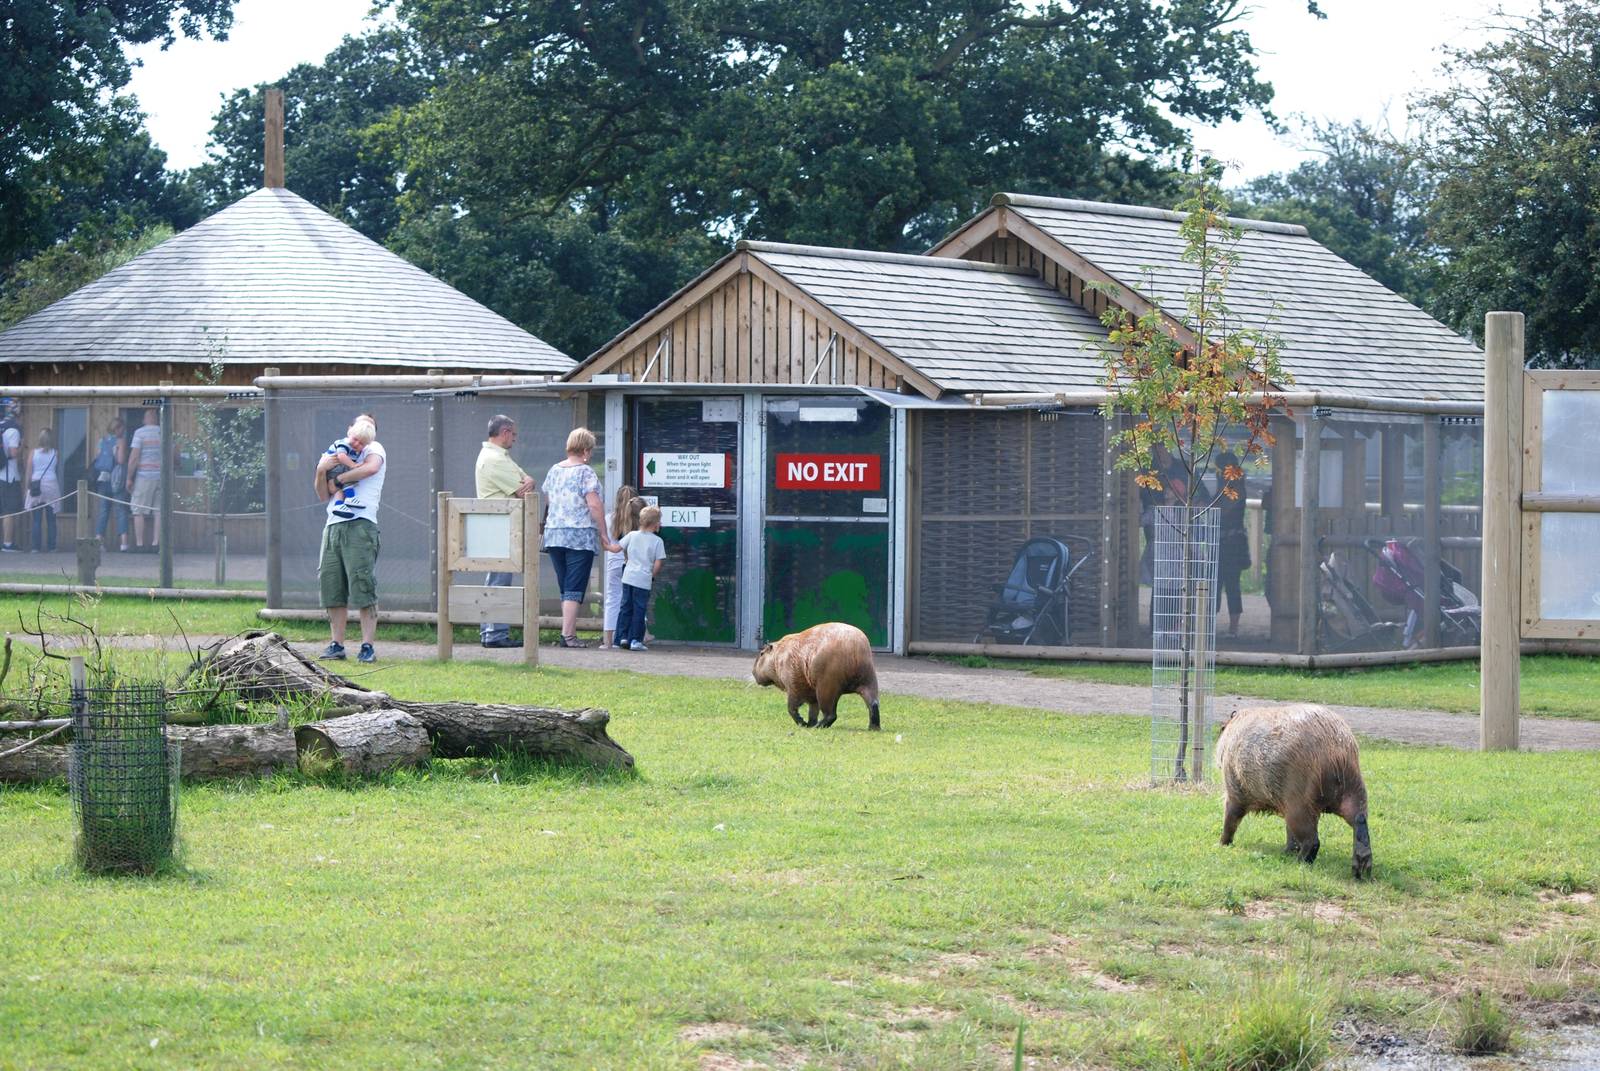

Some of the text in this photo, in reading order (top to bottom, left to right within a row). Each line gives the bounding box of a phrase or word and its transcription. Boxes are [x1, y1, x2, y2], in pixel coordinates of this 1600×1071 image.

[788, 462, 868, 482] NO EXIT
[672, 511, 698, 523] EXIT
